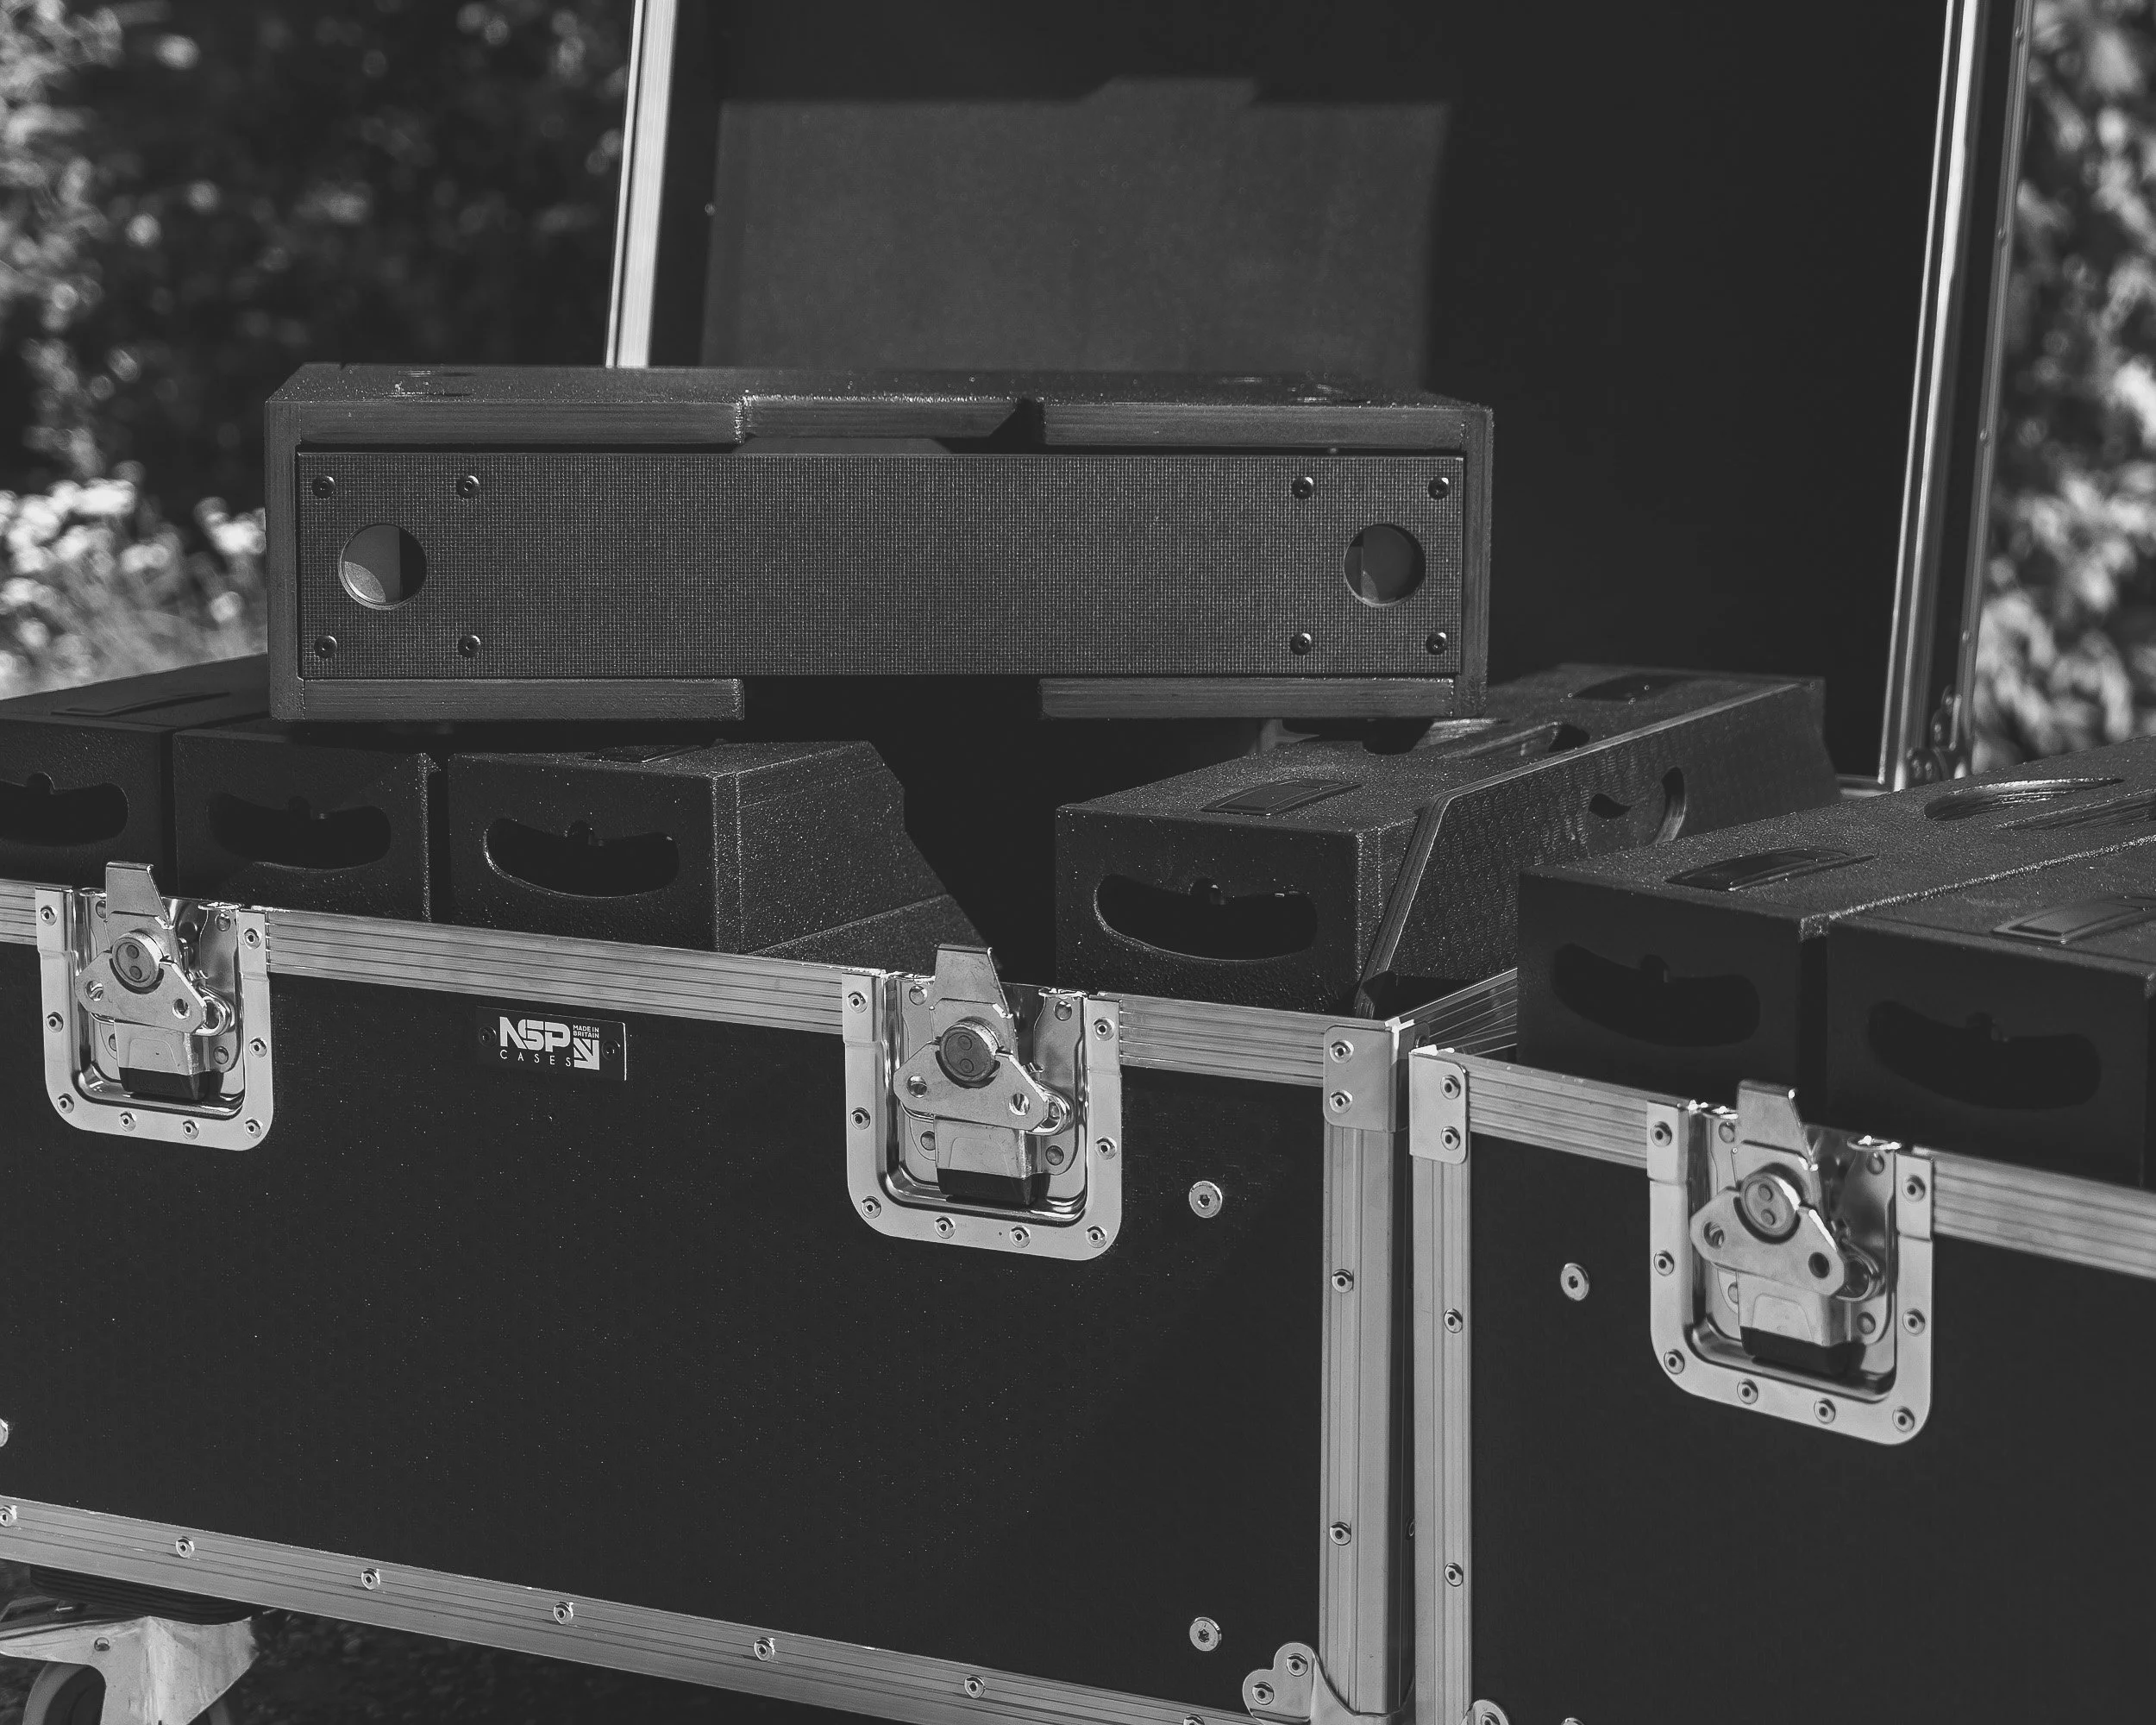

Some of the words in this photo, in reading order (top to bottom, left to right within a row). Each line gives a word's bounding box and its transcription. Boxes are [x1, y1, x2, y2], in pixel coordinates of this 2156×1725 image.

[499, 1016, 571, 1052] NSP
[573, 1024, 592, 1032] MADE
[573, 1030, 599, 1038] BRITAIN
[499, 1049, 571, 1067] CASES
